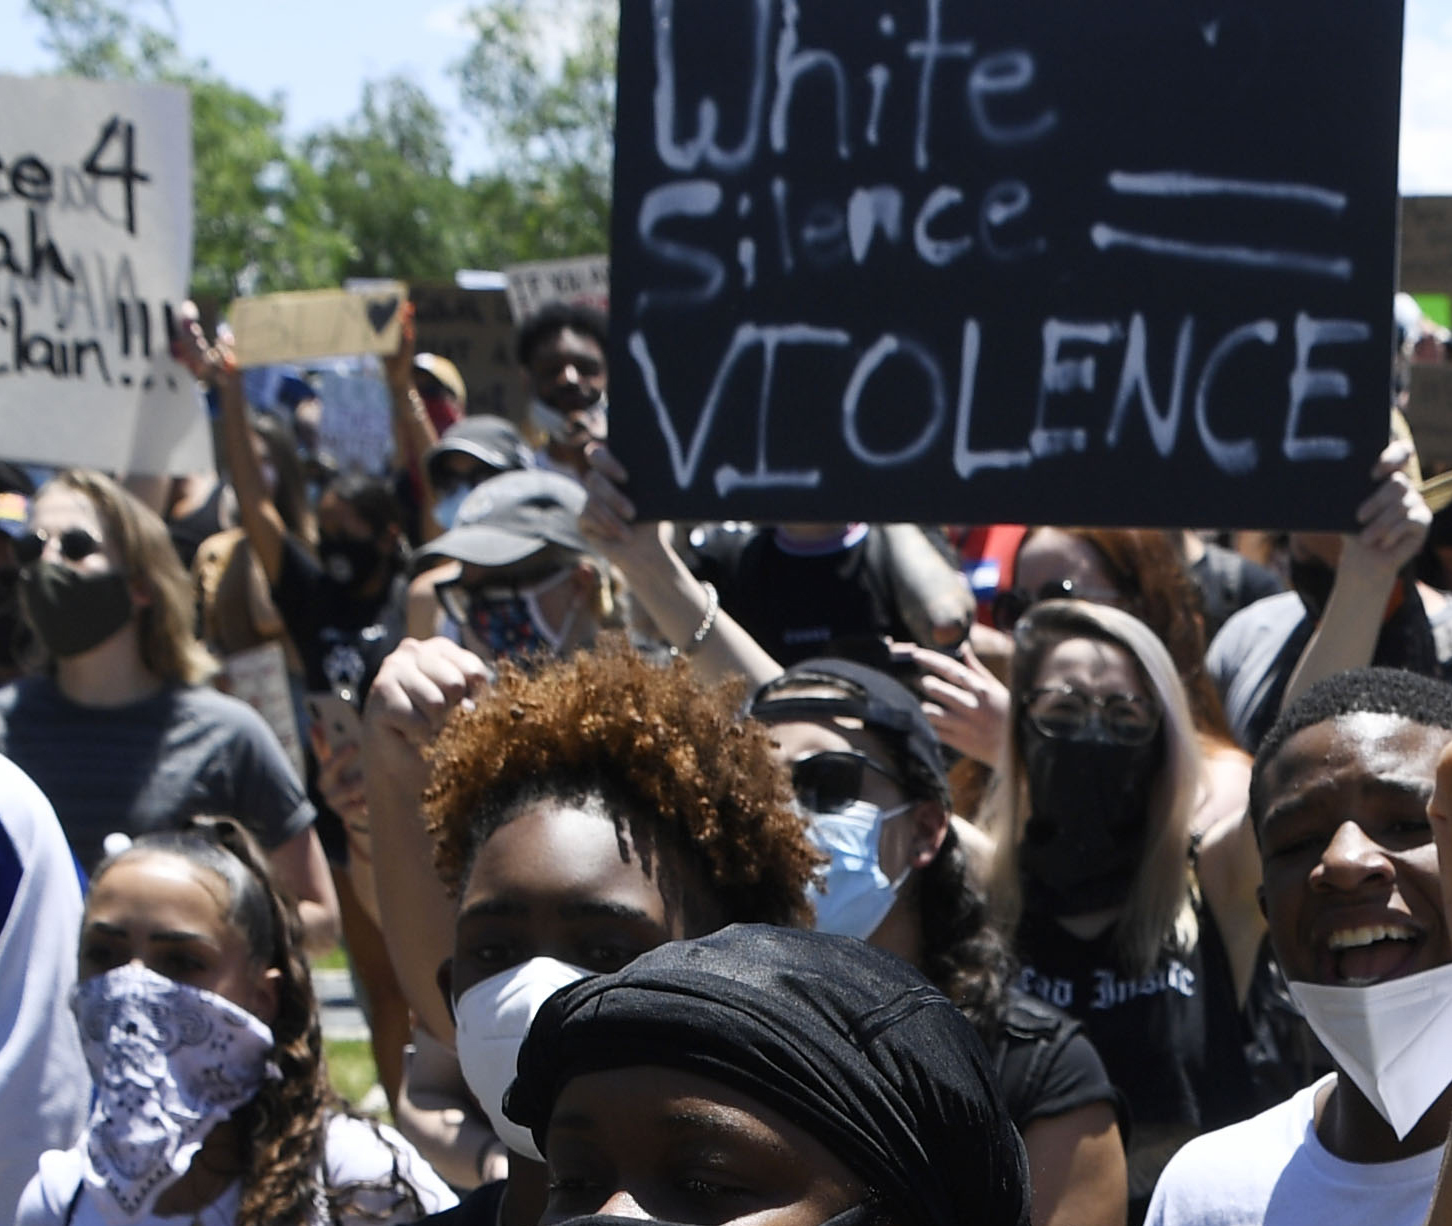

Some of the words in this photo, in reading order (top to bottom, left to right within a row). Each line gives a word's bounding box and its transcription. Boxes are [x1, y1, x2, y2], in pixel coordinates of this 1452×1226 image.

[652, 0, 1059, 172] White
[637, 176, 1047, 312] Silence
[0, 298, 178, 391] lain!!!
[629, 311, 1372, 497] VIOLENCE
